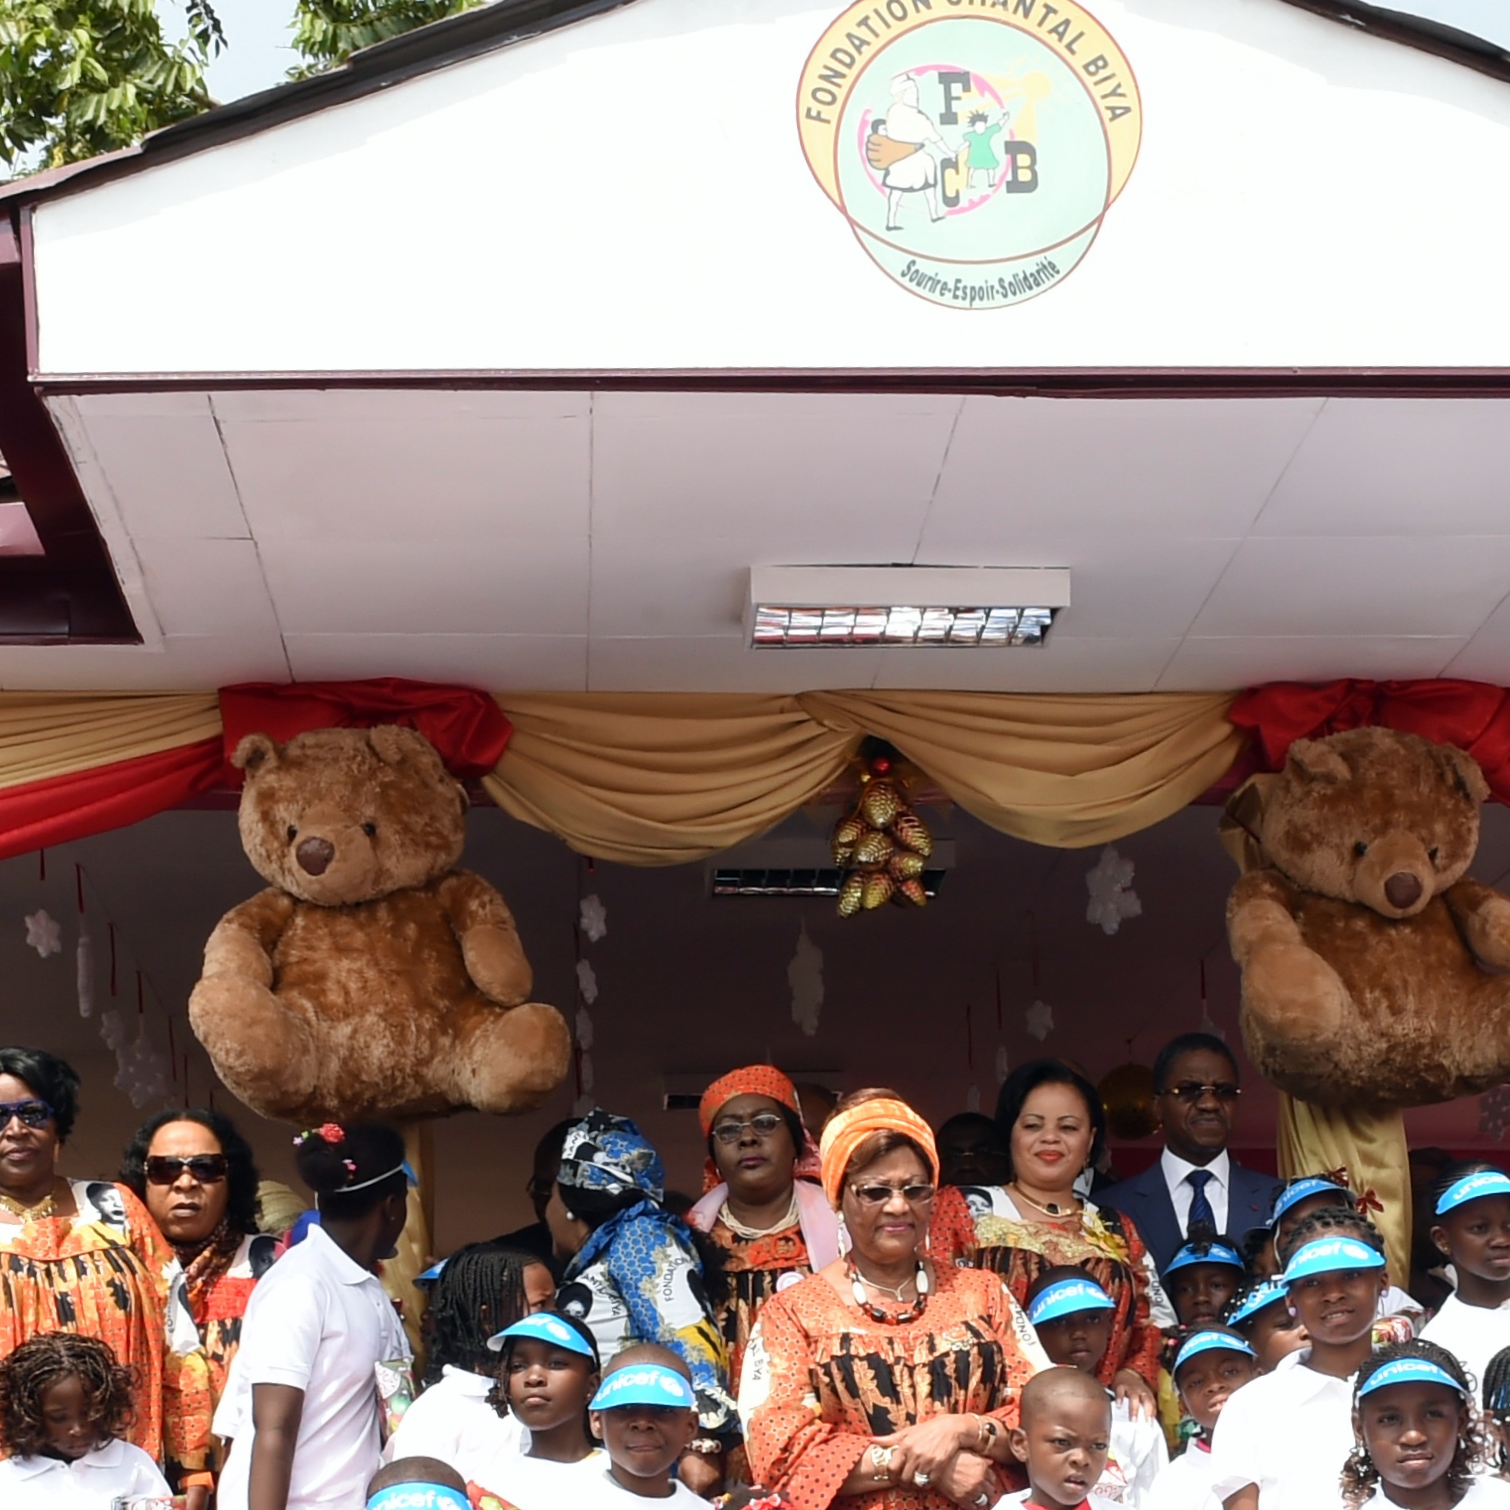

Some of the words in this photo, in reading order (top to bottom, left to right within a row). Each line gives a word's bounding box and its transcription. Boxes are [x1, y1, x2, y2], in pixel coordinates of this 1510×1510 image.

[805, 0, 931, 124] FONDATION
[1082, 53, 1132, 122] BIYA
[938, 71, 971, 125] F
[1004, 140, 1039, 194] B
